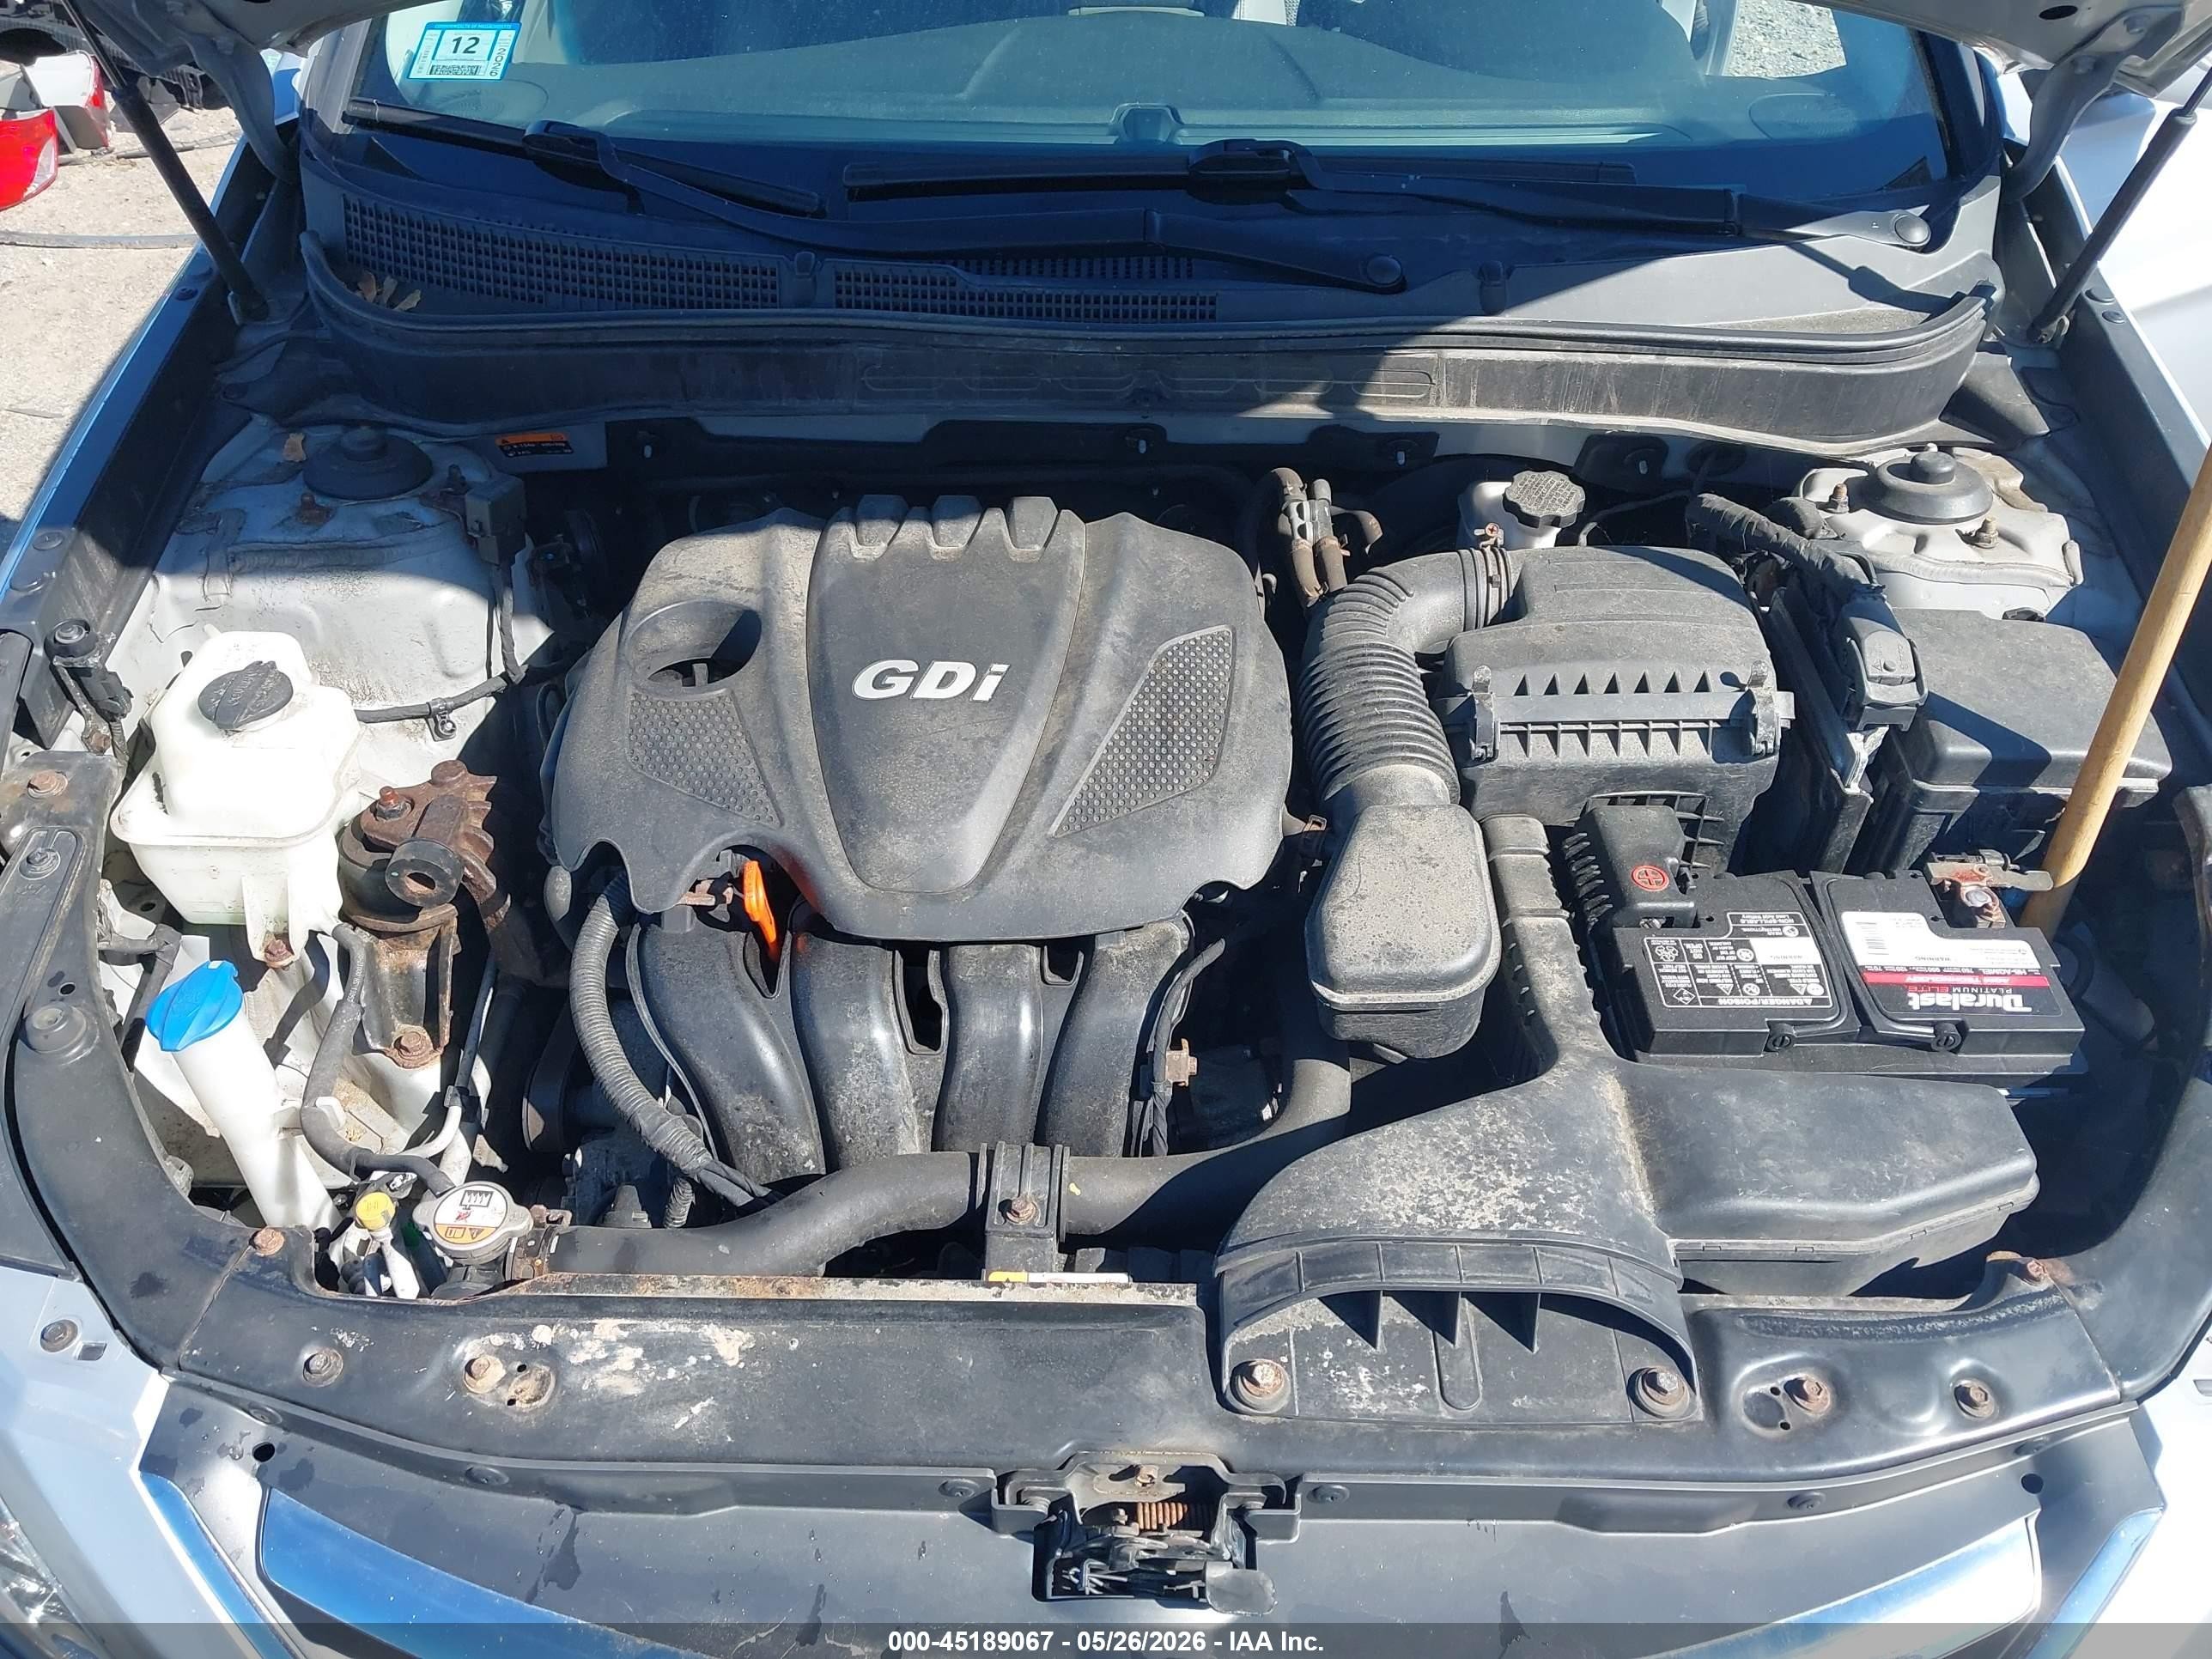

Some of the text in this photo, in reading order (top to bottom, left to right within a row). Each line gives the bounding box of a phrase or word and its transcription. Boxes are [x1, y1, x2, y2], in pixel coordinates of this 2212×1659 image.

[452, 36, 480, 54] 12
[489, 48, 506, 76] 2026
[852, 659, 1010, 701] GDi
[1907, 992, 2033, 1012] Duralast
